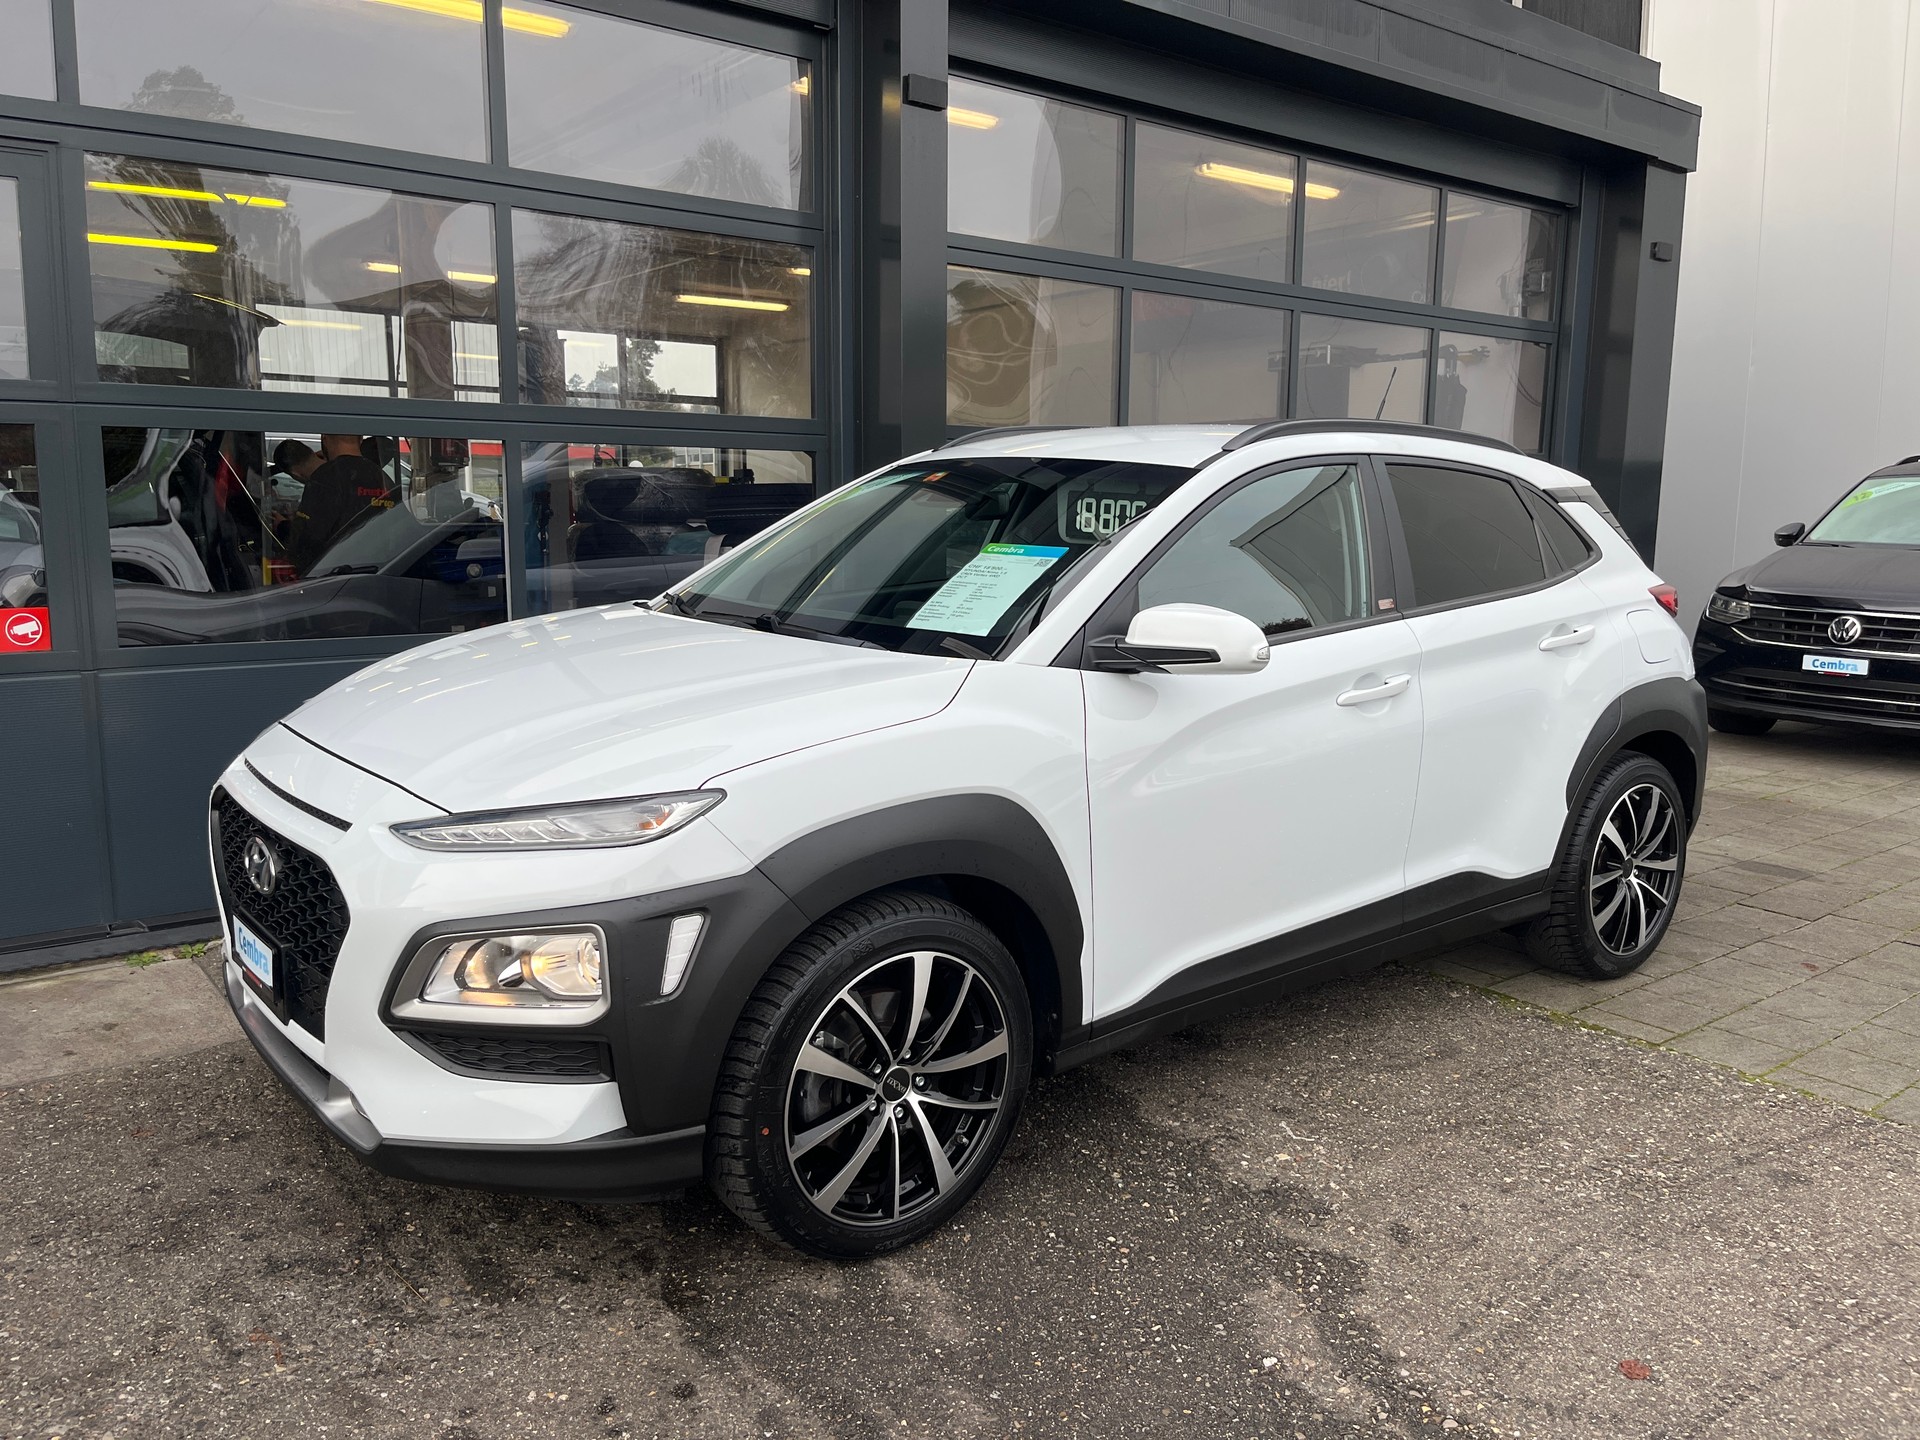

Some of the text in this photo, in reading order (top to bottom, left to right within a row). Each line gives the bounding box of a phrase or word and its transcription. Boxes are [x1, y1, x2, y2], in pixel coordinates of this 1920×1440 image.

[988, 546, 1024, 554] Cembra
[1811, 658, 1858, 672] Cembra
[239, 926, 270, 975] Cembra
